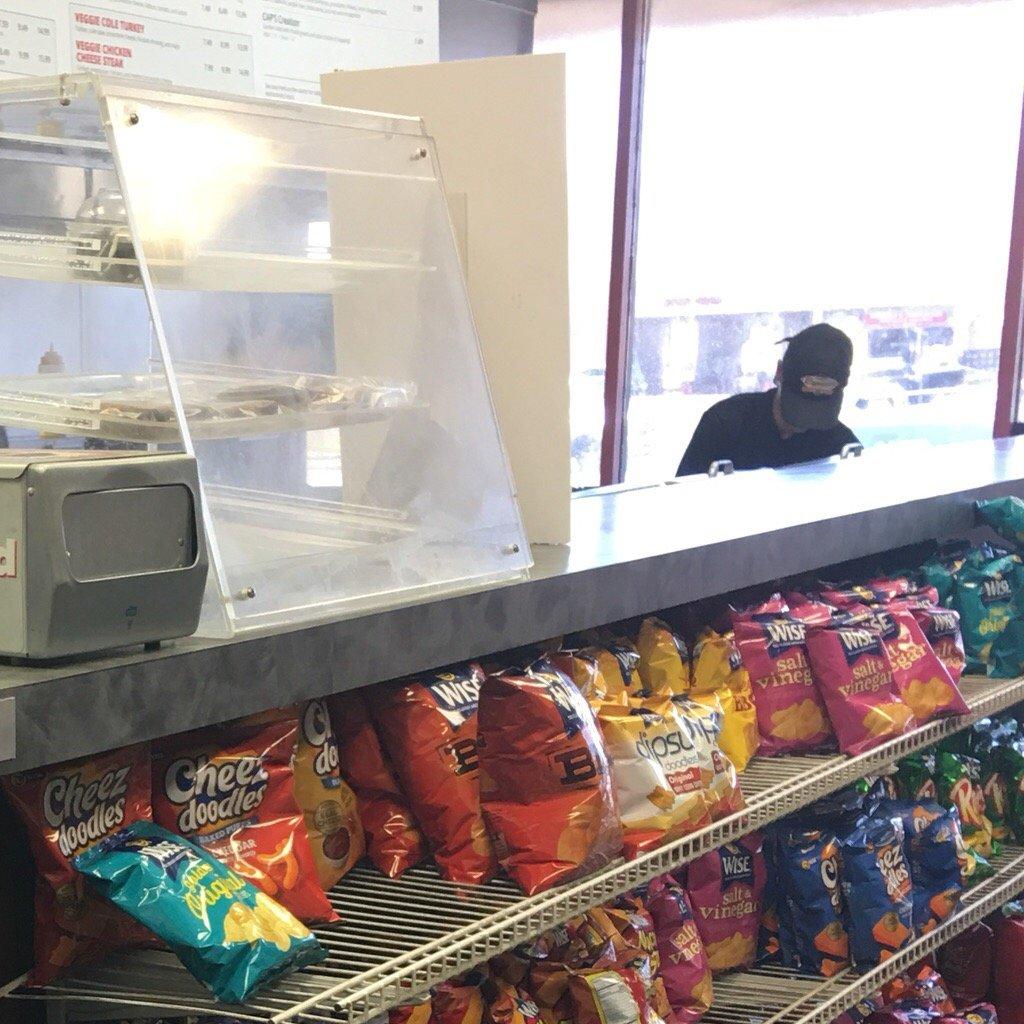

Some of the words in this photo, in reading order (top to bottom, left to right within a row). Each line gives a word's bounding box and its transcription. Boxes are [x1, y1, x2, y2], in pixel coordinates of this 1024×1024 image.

[74, 11, 100, 26] VEGGIE
[102, 17, 119, 29] COLE
[120, 20, 145, 34] TURKEY
[75, 39, 101, 53] VEGGIE
[103, 44, 132, 58] CHICKEN
[76, 52, 102, 66] CHEESE
[102, 56, 124, 69] STEAK
[839, 629, 875, 651] WISE
[852, 660, 876, 680] salt
[164, 754, 269, 804] Cheez
[42, 763, 132, 828] Cheez
[177, 782, 269, 835] doodles
[56, 796, 128, 858] doodles
[722, 856, 751, 877] WISE
[723, 886, 743, 905] salt
